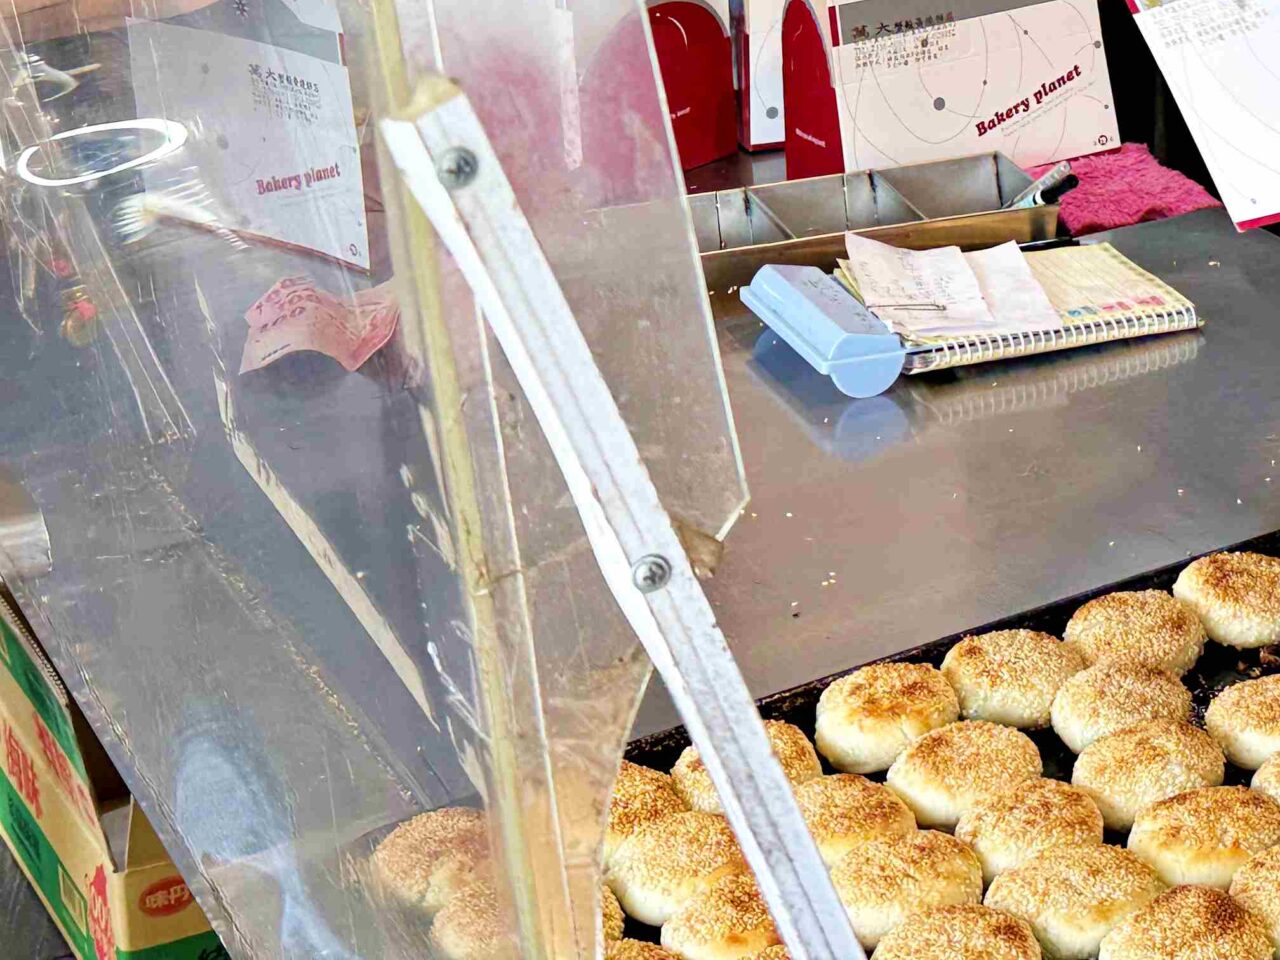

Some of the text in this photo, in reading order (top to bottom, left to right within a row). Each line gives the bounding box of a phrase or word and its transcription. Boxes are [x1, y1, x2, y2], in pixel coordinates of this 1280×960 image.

[975, 97, 1030, 137] Bakery
[1033, 64, 1082, 104] planet
[256, 162, 341, 195] Bakery planet
